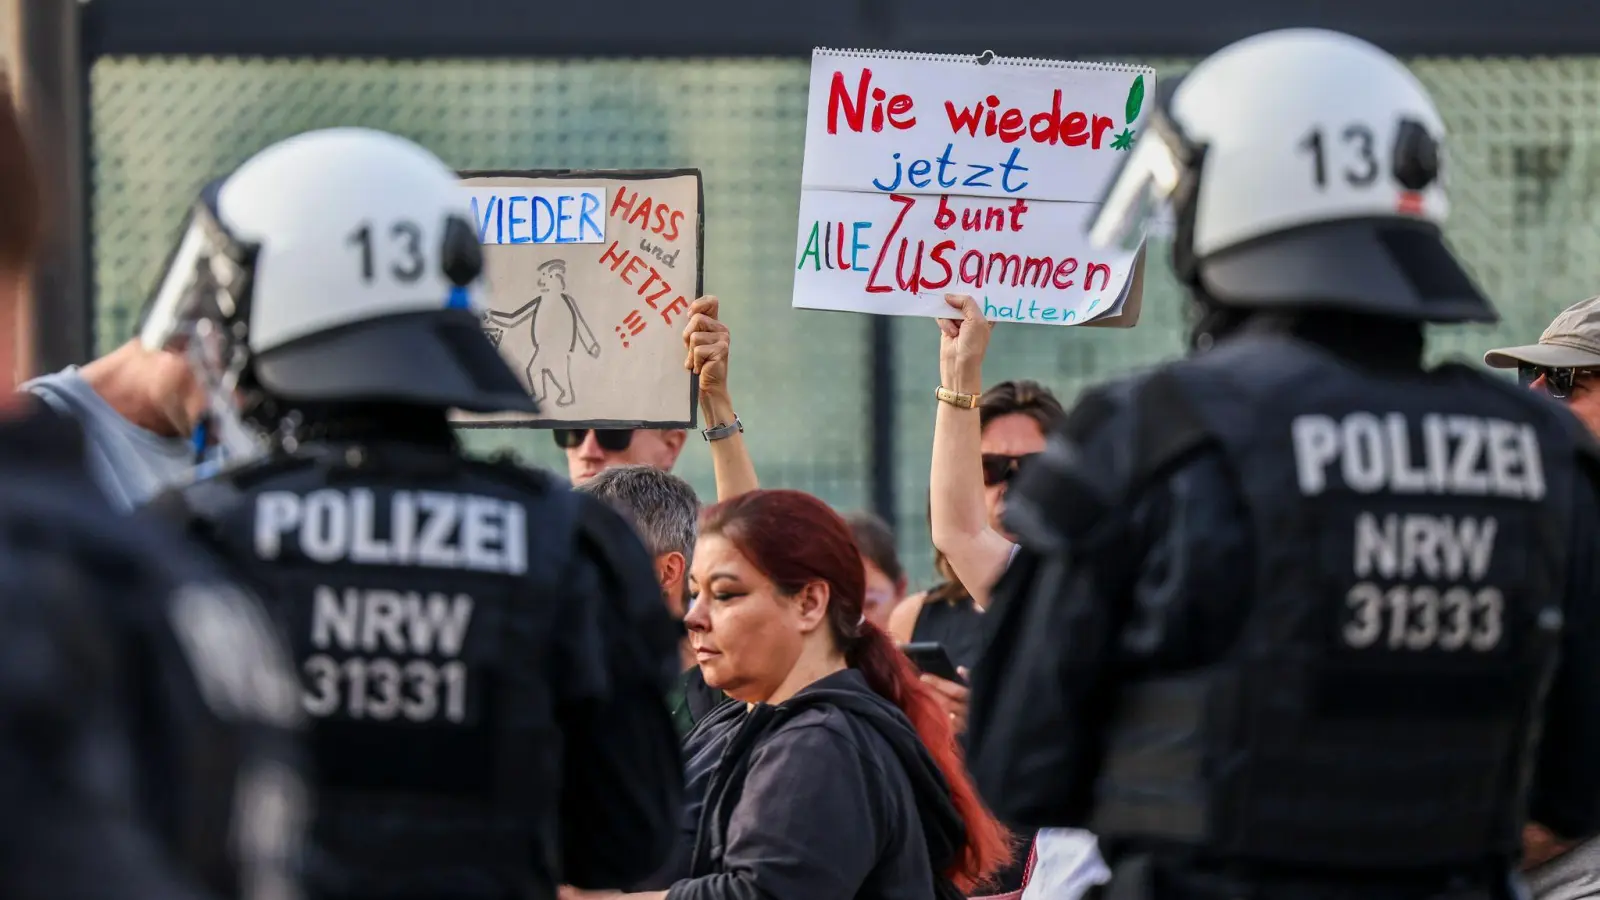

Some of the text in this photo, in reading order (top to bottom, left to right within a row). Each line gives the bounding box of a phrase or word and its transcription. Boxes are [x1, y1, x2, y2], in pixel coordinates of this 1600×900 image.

[827, 68, 917, 135] Nie
[873, 143, 1029, 193] jetzt
[1299, 123, 1379, 190] 13
[610, 186, 684, 241] HASS
[798, 220, 872, 272] ALLE
[934, 194, 1028, 232] bunt
[347, 222, 424, 283] 13
[599, 240, 688, 326] HETZE
[639, 237, 680, 268] und
[1293, 412, 1546, 499] POLIZEI
[255, 489, 528, 574] POLIZEI
[1354, 512, 1497, 579] NRW
[311, 586, 473, 656] NRW
[1343, 583, 1504, 650] 31333
[303, 656, 467, 722] 31331
